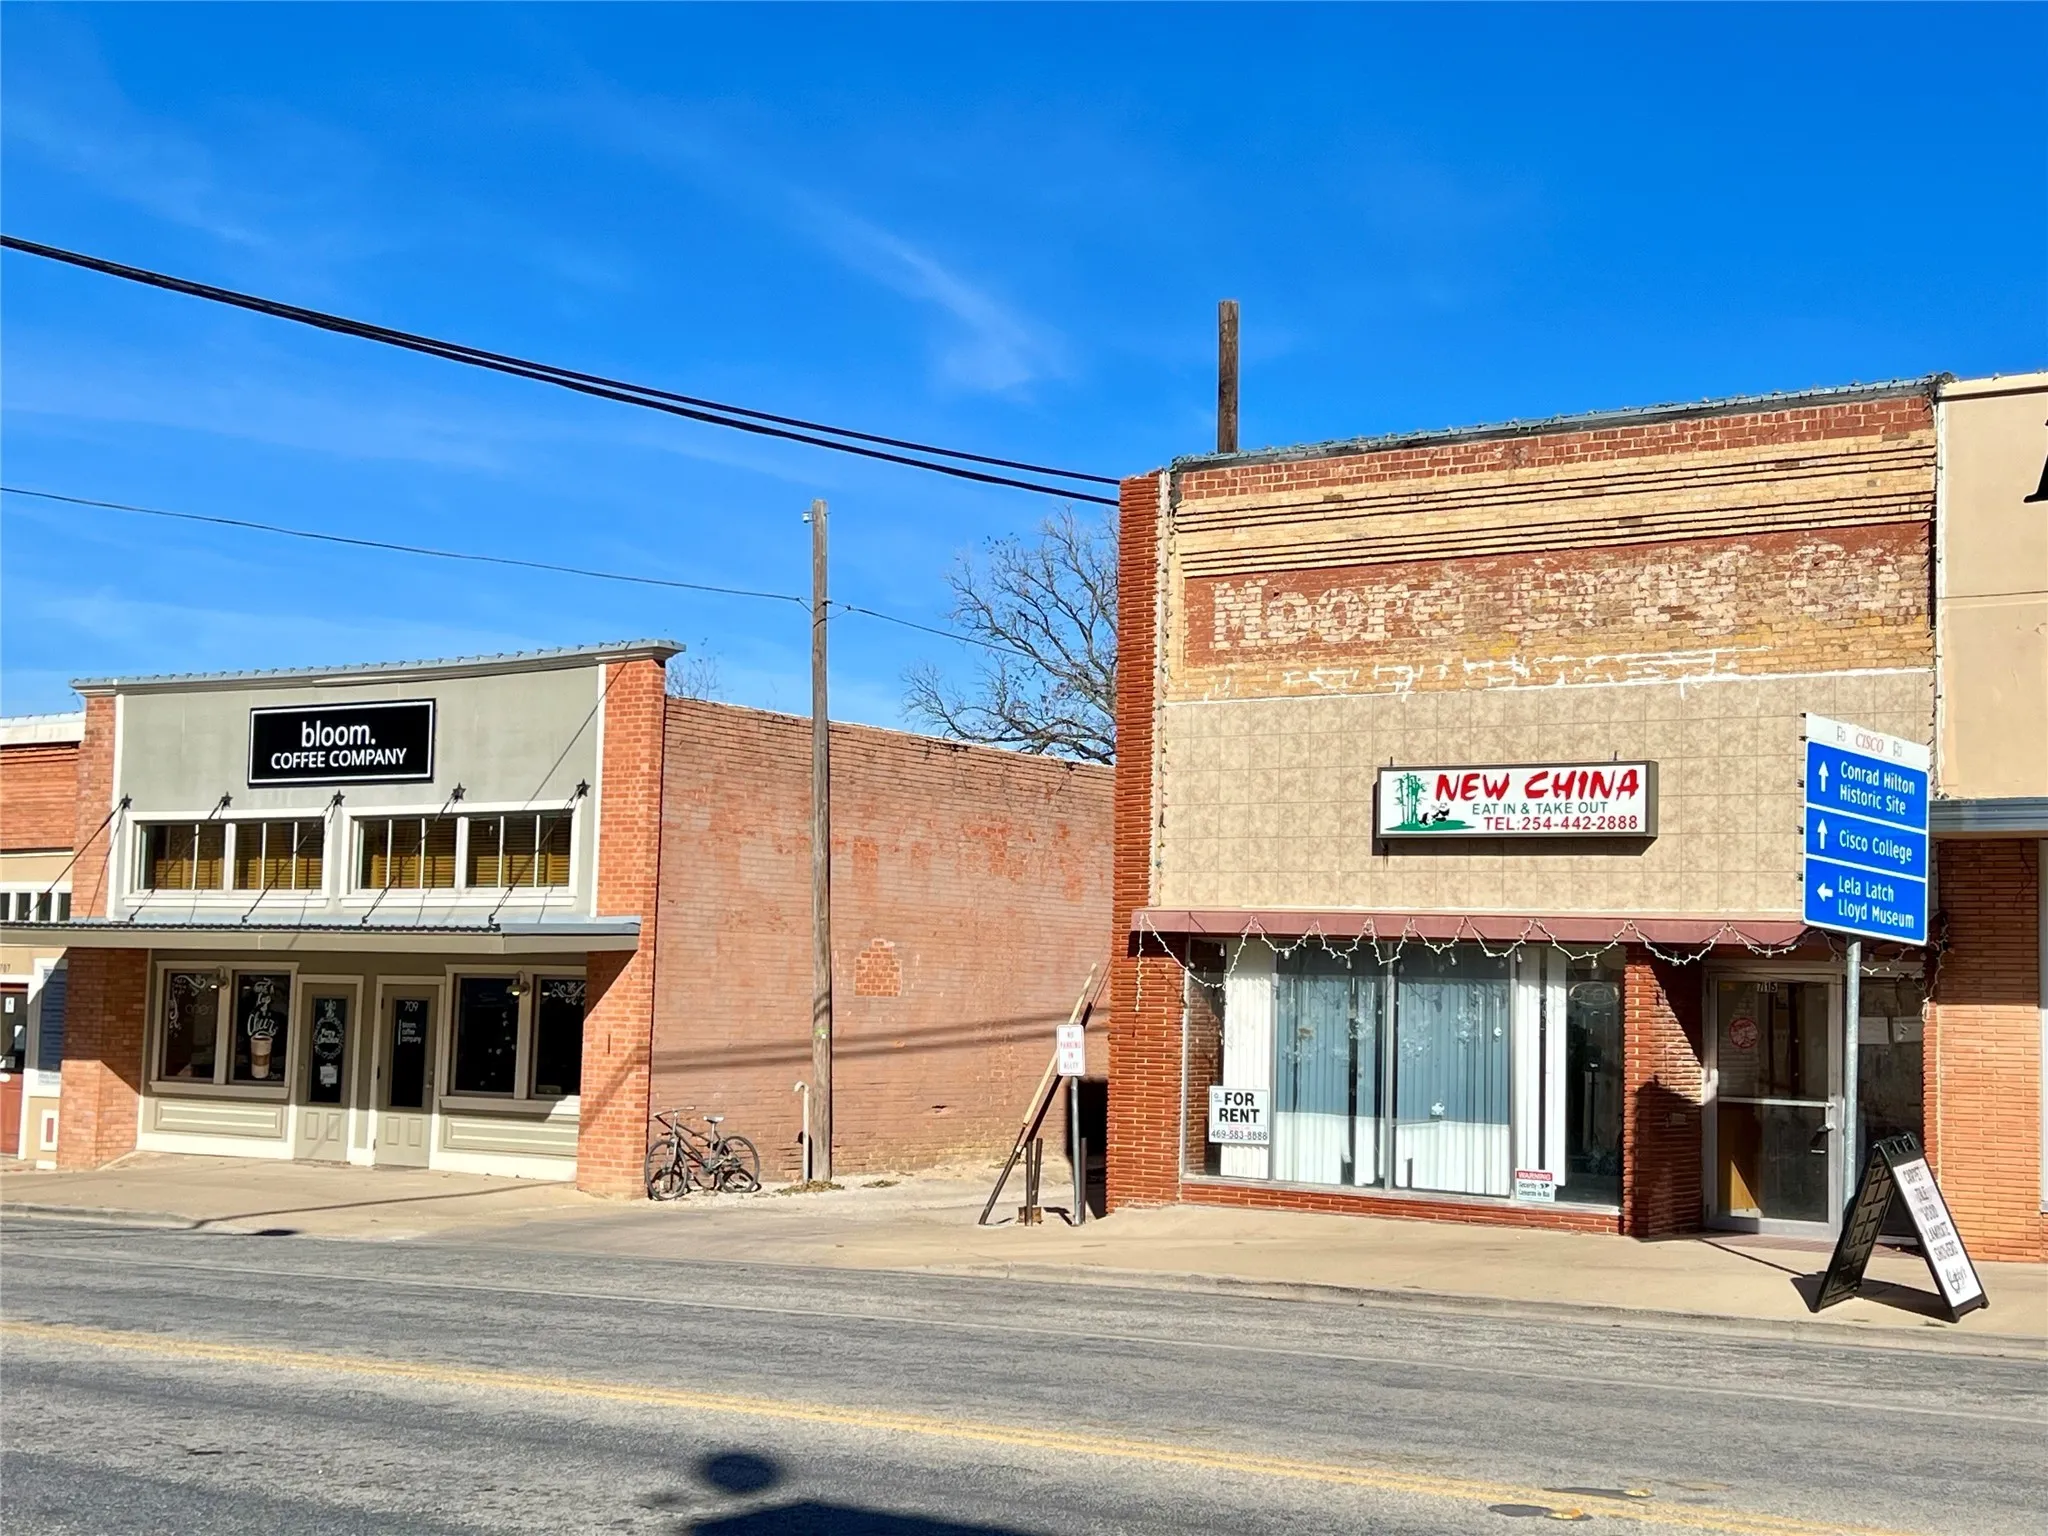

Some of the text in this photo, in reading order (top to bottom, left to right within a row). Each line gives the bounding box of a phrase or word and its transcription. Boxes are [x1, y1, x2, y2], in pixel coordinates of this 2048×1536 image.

[301, 719, 376, 748] bloom.
[1855, 732, 1885, 754] CISCO
[270, 747, 408, 769] COFFEE COMPANY
[1435, 769, 1640, 801] NEW CHINA
[1840, 760, 1916, 796] Conrad Hilton
[1472, 801, 1609, 815] EAT IN & TAKE OUT
[1840, 783, 1906, 816] Historic Site
[1483, 815, 1638, 831] TEL:254-442-2888
[1839, 829, 1913, 865] Cisco College
[1838, 875, 1895, 903] Lela Latch
[1838, 898, 1915, 929] Lloyd Museum
[403, 1001, 419, 1013] 709
[1224, 1091, 1255, 1106] FOR
[1219, 1107, 1260, 1123] RENT
[1517, 1171, 1552, 1180] WARNING
